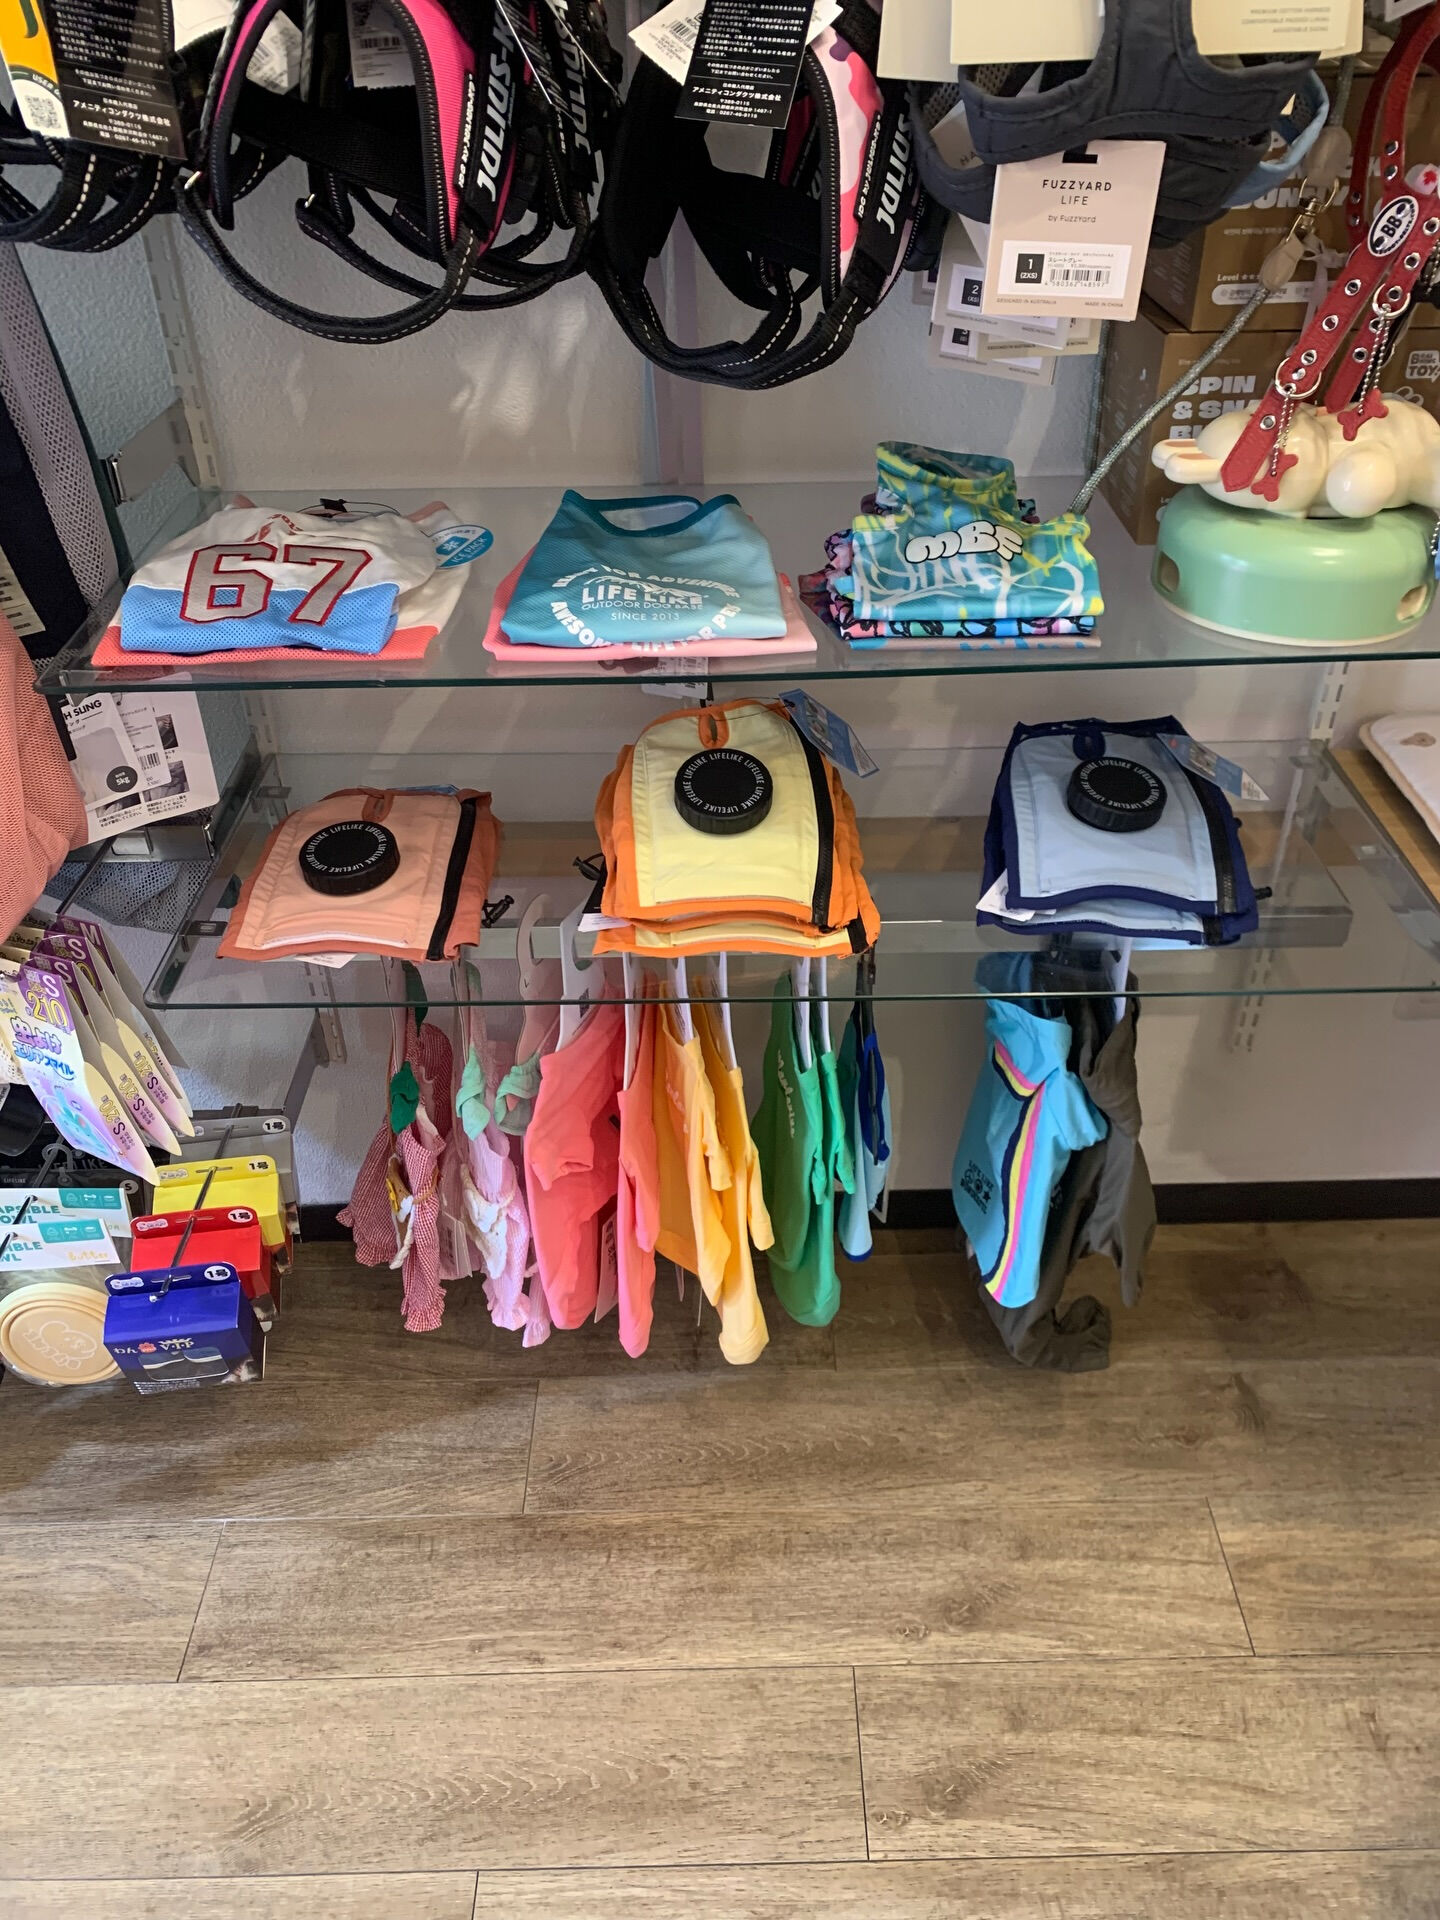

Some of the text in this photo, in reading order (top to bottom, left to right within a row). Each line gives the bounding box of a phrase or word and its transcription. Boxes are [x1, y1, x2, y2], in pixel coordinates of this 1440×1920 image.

[32, 74, 54, 92] USER
[692, 86, 782, 102] アメニティコンダクツ株式会社
[73, 100, 171, 127] アメニティコンダクツ株式会社
[1042, 179, 1112, 191] FUZZYARD
[1061, 195, 1089, 206] LIFE
[1048, 214, 1057, 222] by
[1381, 216, 1402, 237] BB
[1028, 258, 1033, 270] 1
[1217, 273, 1239, 282] Level
[971, 284, 979, 295] 2
[1181, 376, 1256, 396] SPIN
[1172, 402, 1192, 420] &
[179, 541, 373, 626] 67
[582, 585, 703, 605] LIFE LIKE
[581, 600, 641, 611] OUTDOOR
[643, 601, 671, 609] DOG
[611, 612, 680, 621] SINCE 2013
[73, 700, 102, 717] SLING
[709, 752, 743, 763] LIFELIKE
[683, 757, 707, 779] LIFELIKE
[744, 760, 765, 785] LIFELIKE
[116, 776, 131, 786] 5kg
[682, 781, 703, 806] LIFELIKE
[740, 787, 765, 810] LIFELIKE
[703, 803, 739, 814] LIFELIKE
[80, 922, 101, 946] M
[67, 939, 86, 960] S
[54, 961, 72, 984] S
[42, 974, 60, 998] S
[147, 1077, 158, 1089] S
[133, 1098, 145, 1111] S
[113, 1122, 125, 1135] S
[265, 1121, 285, 1130] 1号
[249, 1161, 269, 1170] 1号
[125, 1183, 132, 1191] S
[230, 1212, 250, 1220] 1号
[207, 1268, 228, 1278] 1号
[113, 1345, 138, 1354] わん
